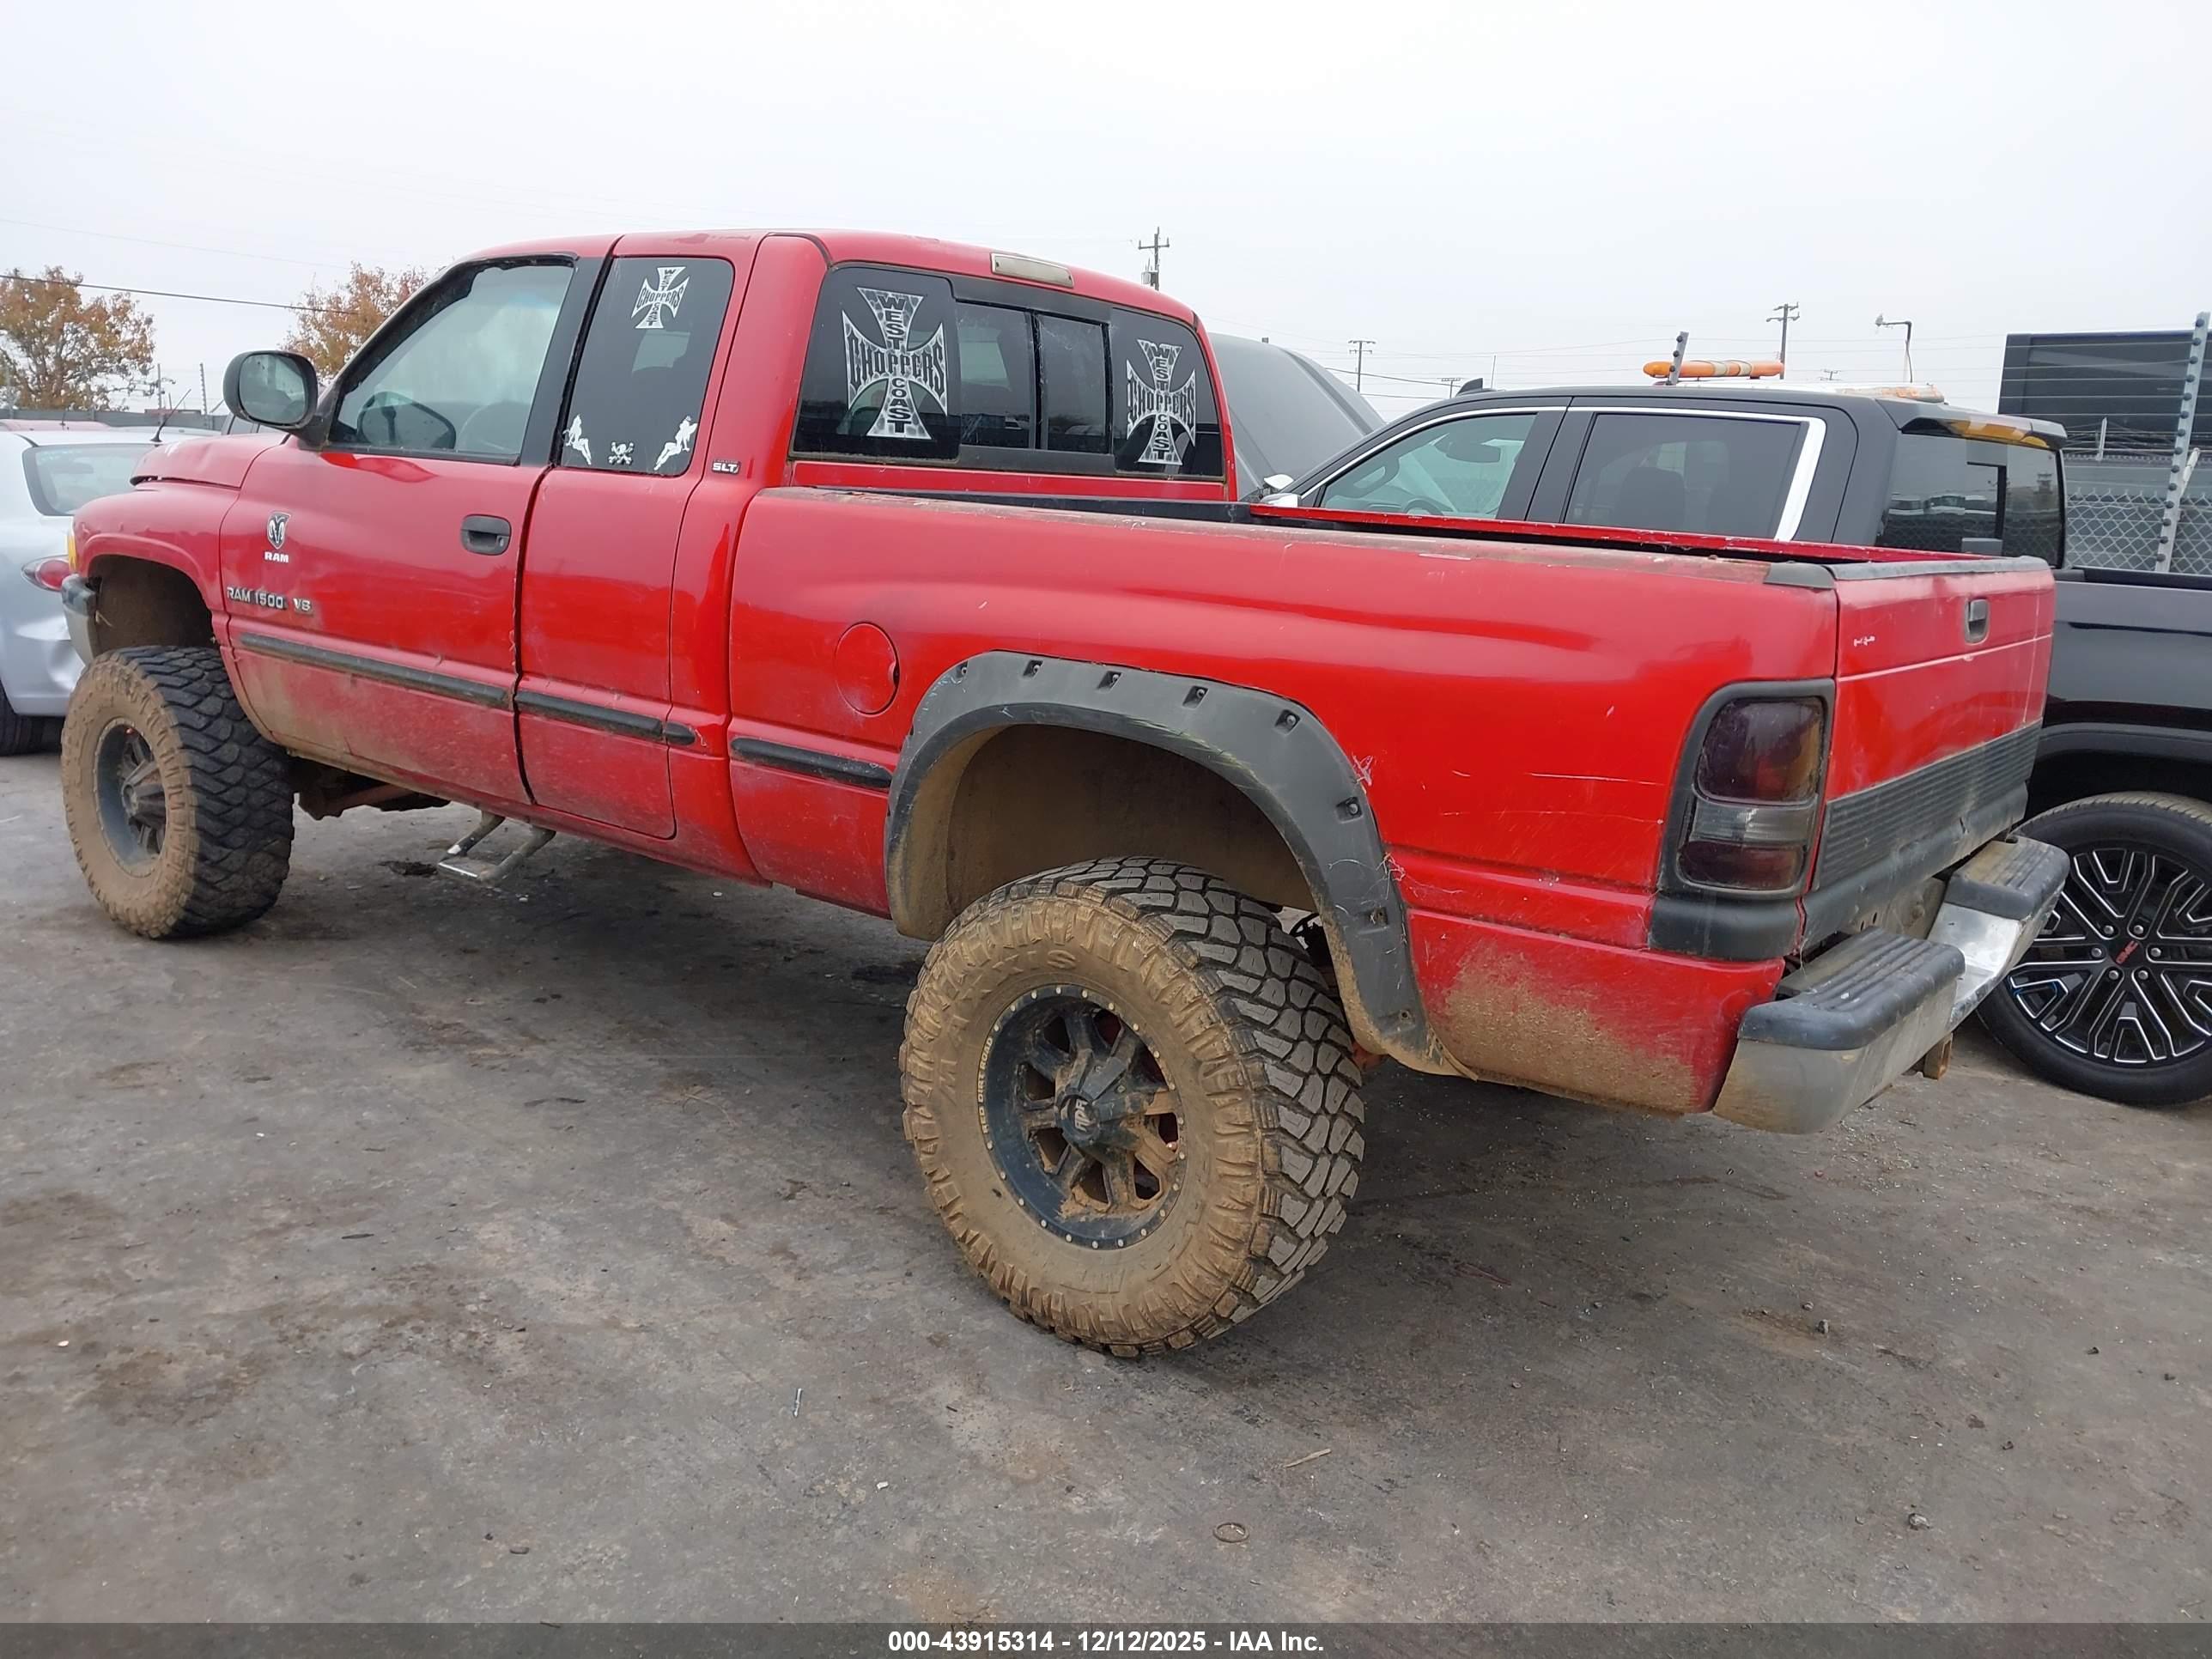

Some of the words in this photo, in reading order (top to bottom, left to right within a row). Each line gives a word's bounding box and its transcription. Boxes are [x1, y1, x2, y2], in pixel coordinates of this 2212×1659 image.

[877, 295, 907, 350] WEST
[848, 333, 945, 397] CHOPPERS
[1151, 345, 1170, 392] WEST
[887, 378, 912, 434] COAST
[1127, 379, 1194, 429] CHOPPERS
[1152, 414, 1170, 460] COAST
[712, 462, 738, 473] SLT
[264, 551, 289, 563] RAM
[227, 587, 251, 602] RAM
[255, 591, 284, 609] 1500
[980, 1036, 994, 1069] ROAD
[977, 1071, 986, 1103] DIRT
